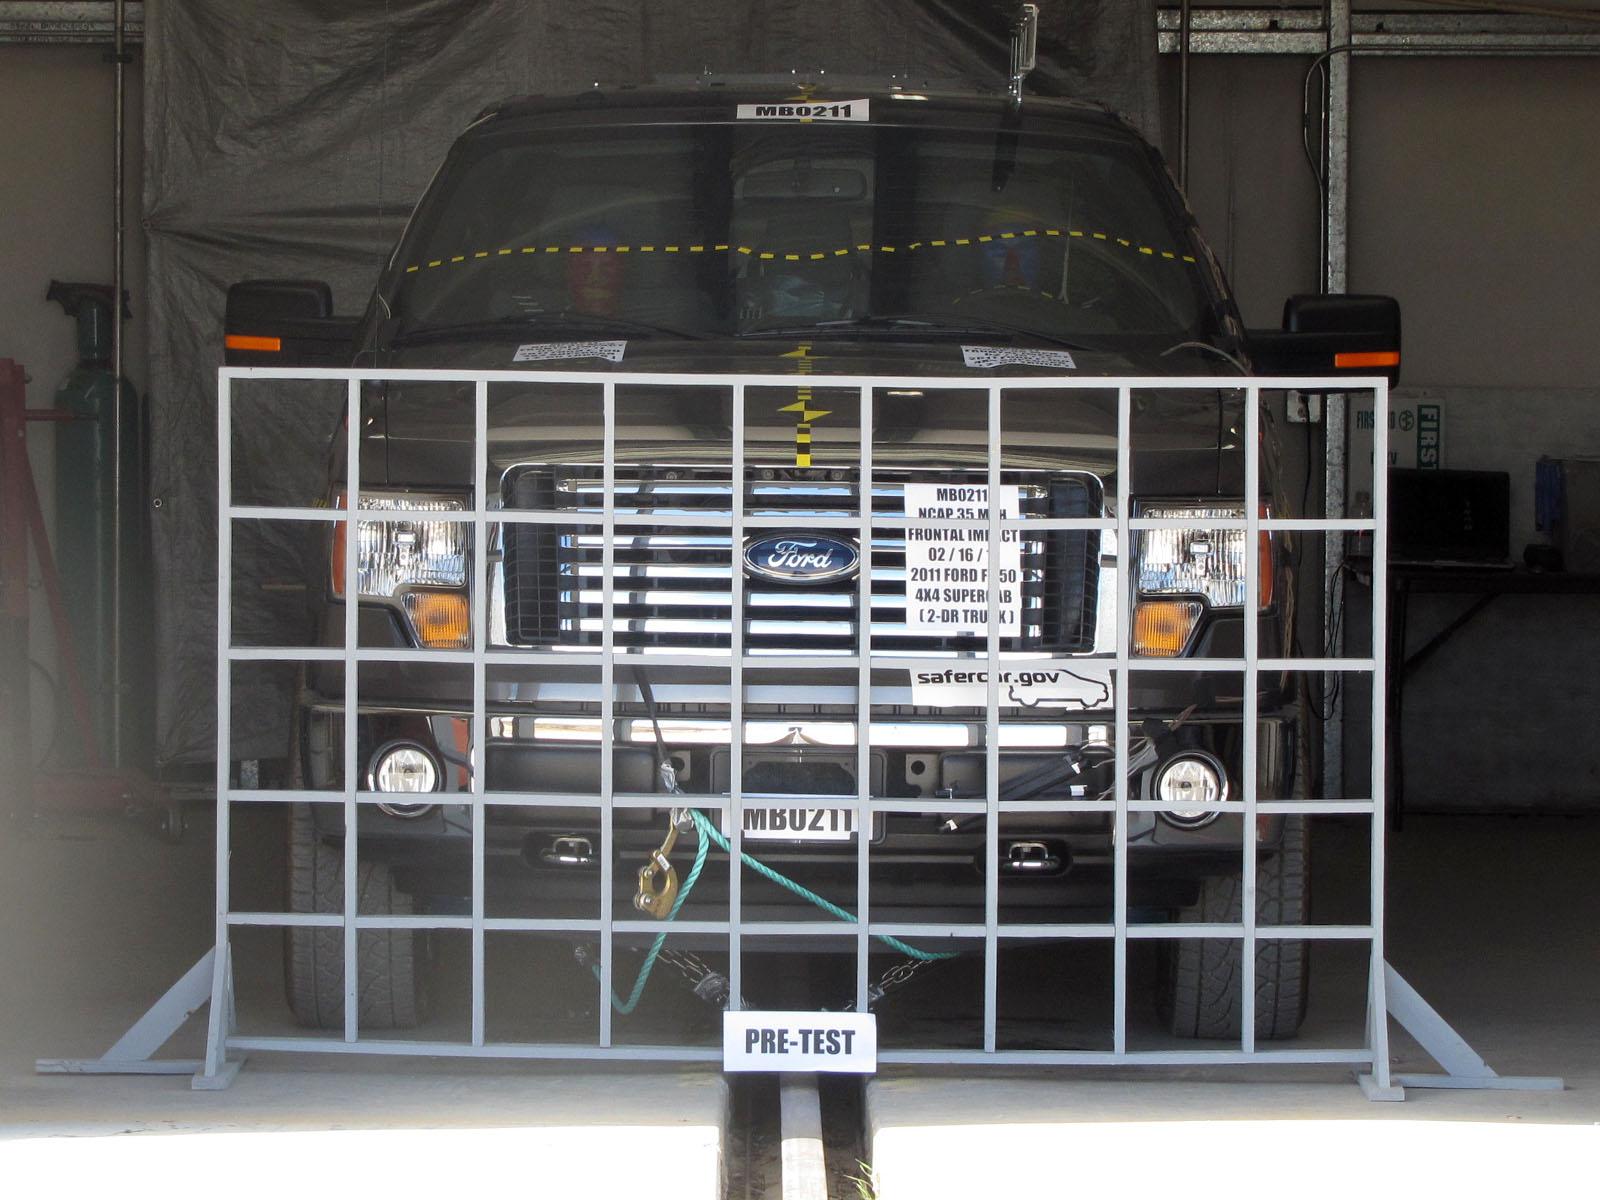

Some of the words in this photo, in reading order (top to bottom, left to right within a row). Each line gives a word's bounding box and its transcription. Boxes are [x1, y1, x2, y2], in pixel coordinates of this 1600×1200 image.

[755, 105, 852, 118] MB0211
[936, 487, 988, 503] MB0211
[918, 507, 954, 519] NCAP
[956, 507, 974, 519] 35
[977, 507, 1008, 519] MH
[908, 528, 966, 542] FRONTAL
[968, 529, 1018, 543] IMCT
[768, 540, 834, 568] Ford
[928, 547, 946, 562] 02
[959, 547, 974, 563] 16
[910, 567, 942, 583] 2011
[943, 568, 978, 583] FORD
[981, 568, 1017, 584] F50
[915, 588, 941, 603] 4X4
[943, 588, 1013, 604] SUPERB
[927, 608, 960, 624] 2-DR
[963, 609, 1007, 624] TRUK
[917, 669, 1060, 687] safercr.gov
[743, 807, 852, 832] MB0211
[745, 1028, 856, 1055] PRE-TEST
